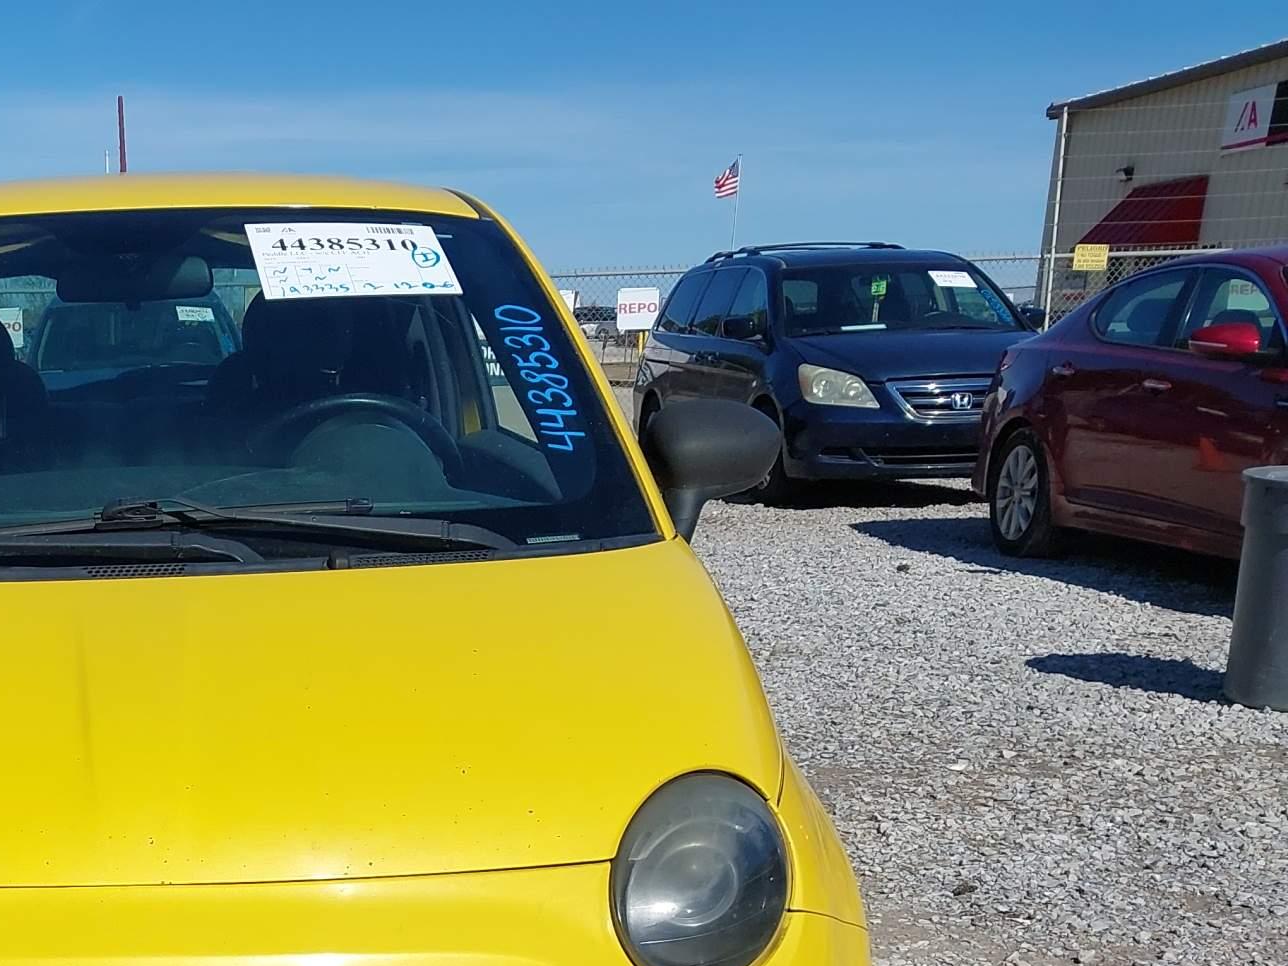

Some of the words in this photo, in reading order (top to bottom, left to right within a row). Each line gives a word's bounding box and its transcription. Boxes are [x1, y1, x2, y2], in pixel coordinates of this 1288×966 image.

[272, 238, 417, 251] 44385310
[618, 302, 658, 315] REPO
[494, 304, 586, 451] 44385310
